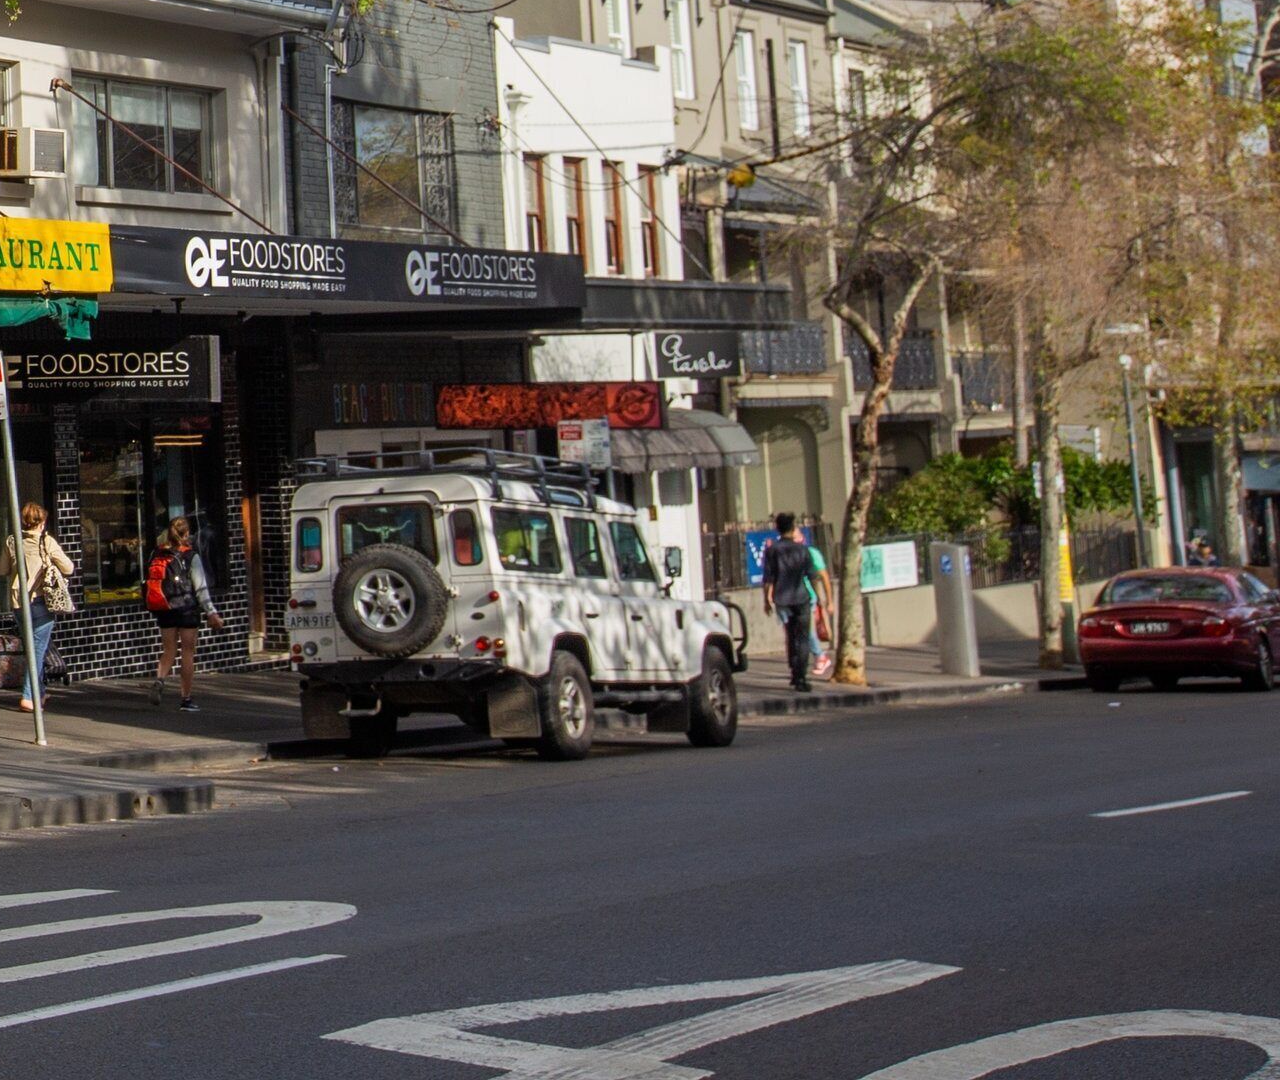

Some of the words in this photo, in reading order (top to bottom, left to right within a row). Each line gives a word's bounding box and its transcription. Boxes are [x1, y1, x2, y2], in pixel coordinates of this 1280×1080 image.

[229, 238, 346, 273] FOODSTORES
[441, 252, 537, 281] FOODSTORES
[232, 278, 259, 288] QUALITY
[261, 279, 279, 289] FOOD
[280, 280, 310, 291] SHOPPING
[312, 282, 329, 292] MADE
[331, 283, 346, 293] EASY
[26, 351, 190, 375] FOODSTORES
[28, 381, 63, 389] QUALITY
[167, 379, 190, 387] EASY
